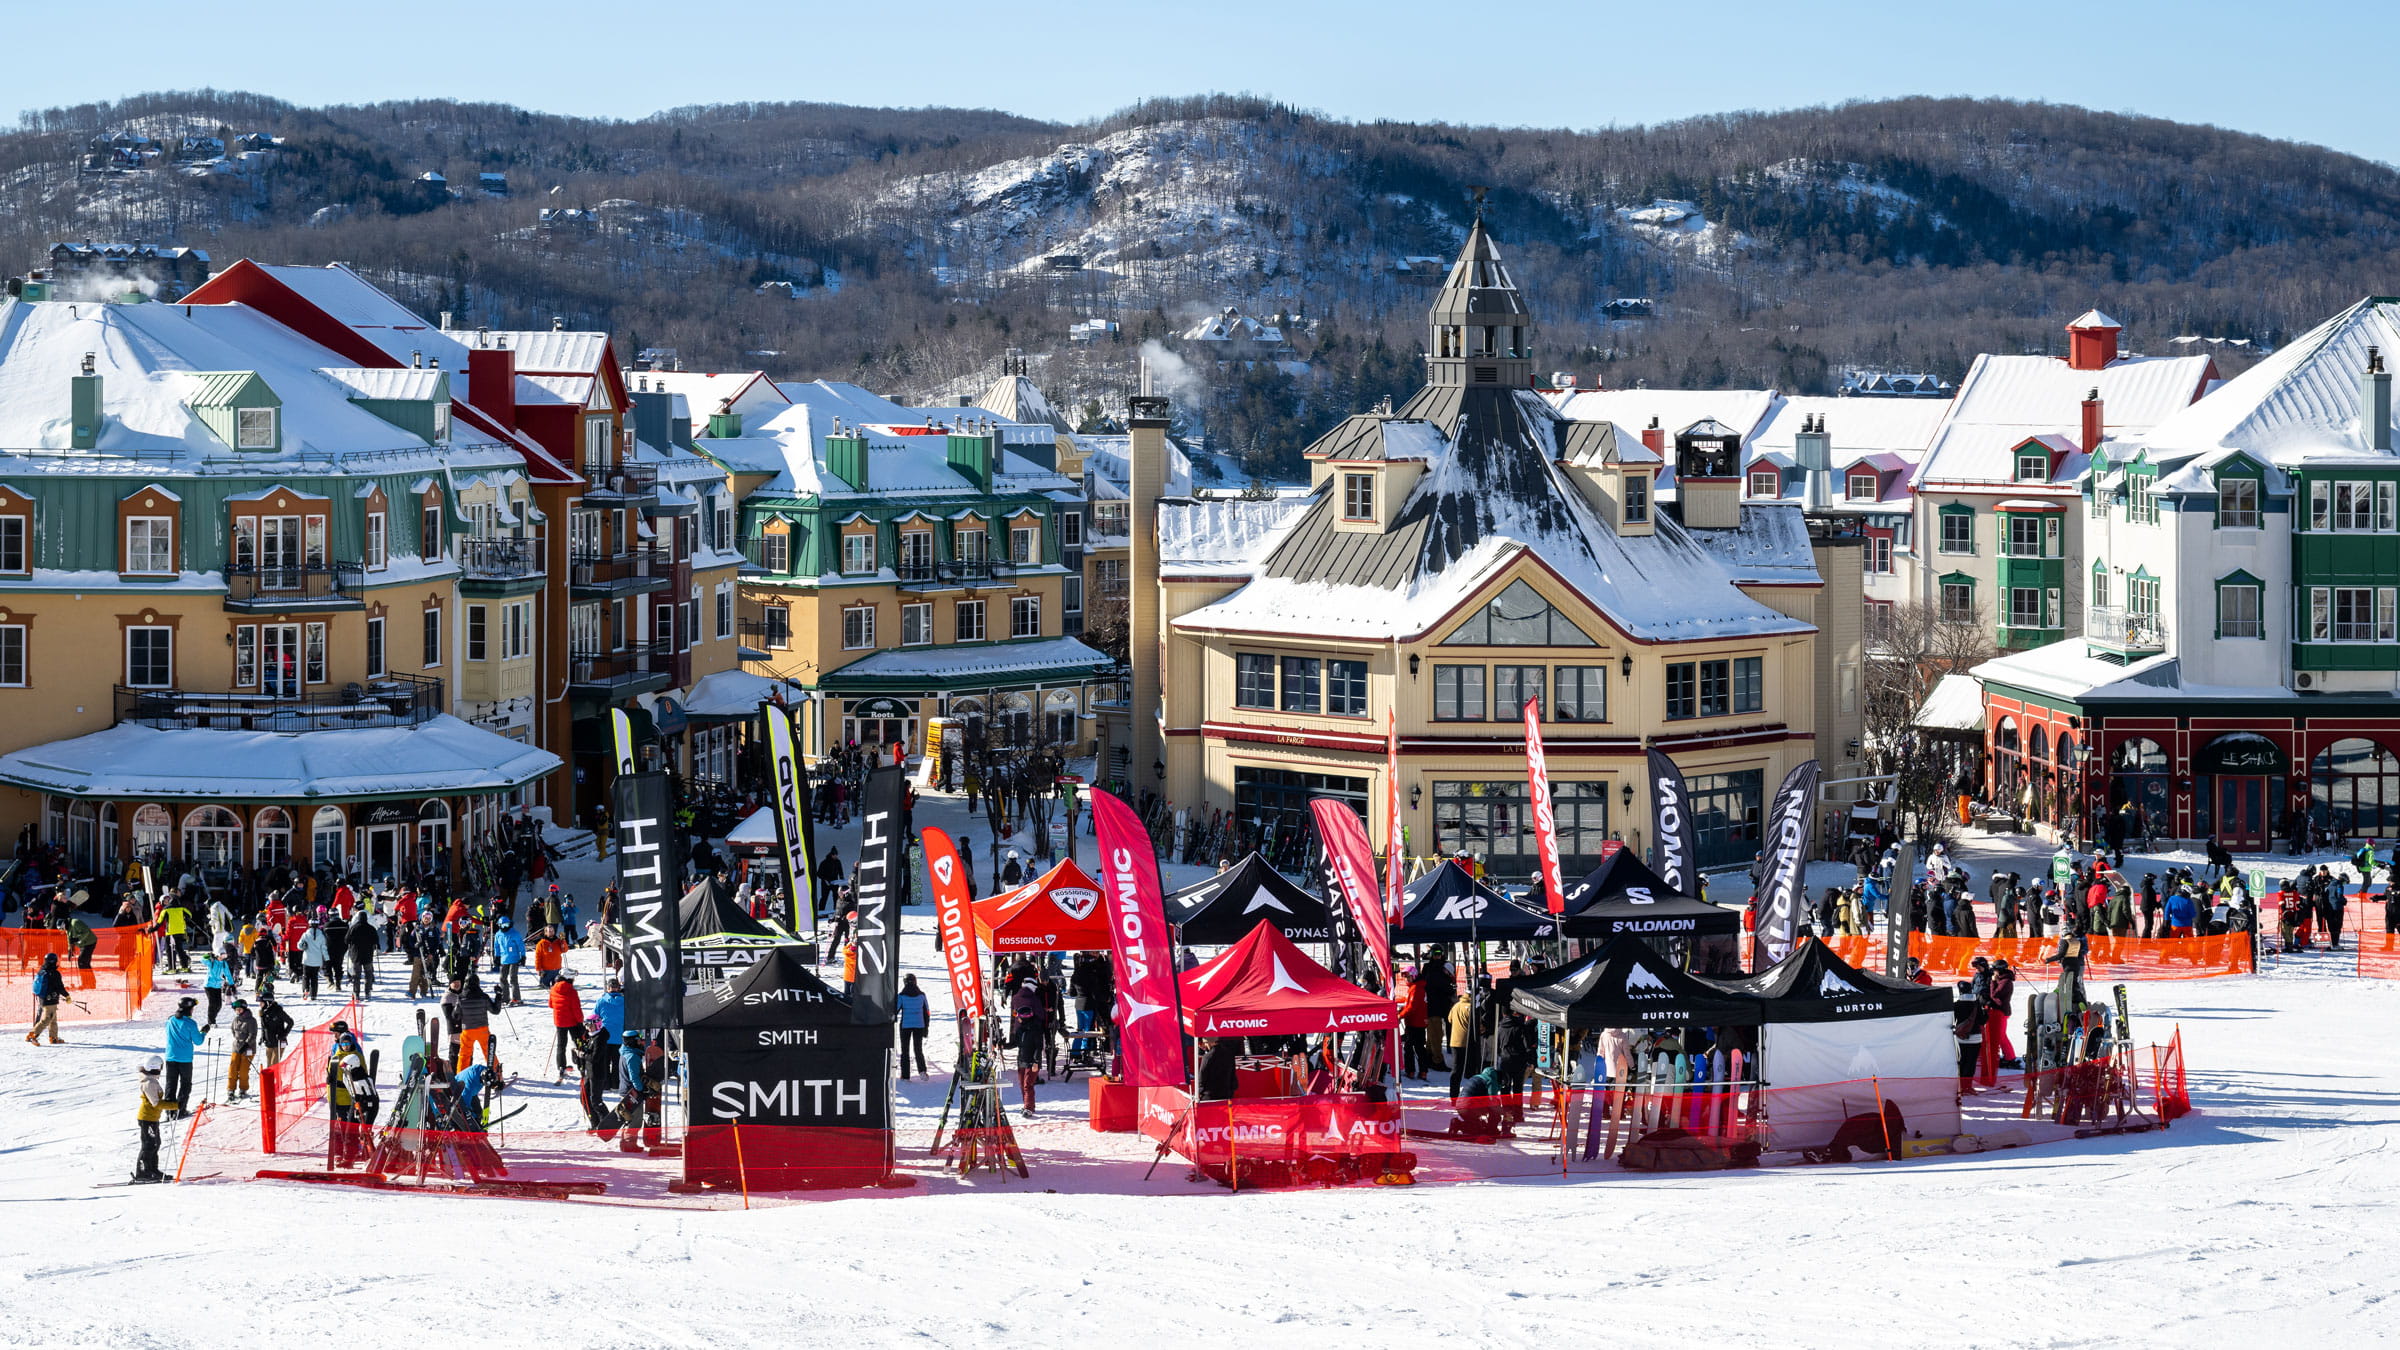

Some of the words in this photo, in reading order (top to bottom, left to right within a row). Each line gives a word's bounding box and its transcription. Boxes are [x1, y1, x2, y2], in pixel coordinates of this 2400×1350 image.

[1277, 735, 1285, 743] LA
[2240, 751, 2277, 767] SHACK
[370, 806, 400, 822] Alpine
[779, 755, 806, 879] HEAD
[1767, 789, 1804, 965] ALOMON
[1055, 890, 1093, 898] ROSSIGNOL
[2285, 897, 2295, 909] 15
[1533, 924, 1554, 937] K2
[1611, 919, 1696, 933] SALOMON
[999, 936, 1045, 945] ROSSIGNOL
[1892, 912, 1903, 978] BURT
[743, 988, 824, 1006] SMITH
[1628, 993, 1675, 1001] BURTON
[1835, 1002, 1883, 1014] BURTON
[1340, 1012, 1388, 1024] ATOMIC
[1642, 1011, 1690, 1020] BURTON
[1220, 1018, 1268, 1029] ATOMIC
[758, 1029, 818, 1046] SMITH
[1540, 1024, 1548, 1054] BURTON
[712, 1078, 867, 1119] SMITH
[1197, 1123, 1282, 1143] ATOMIC
